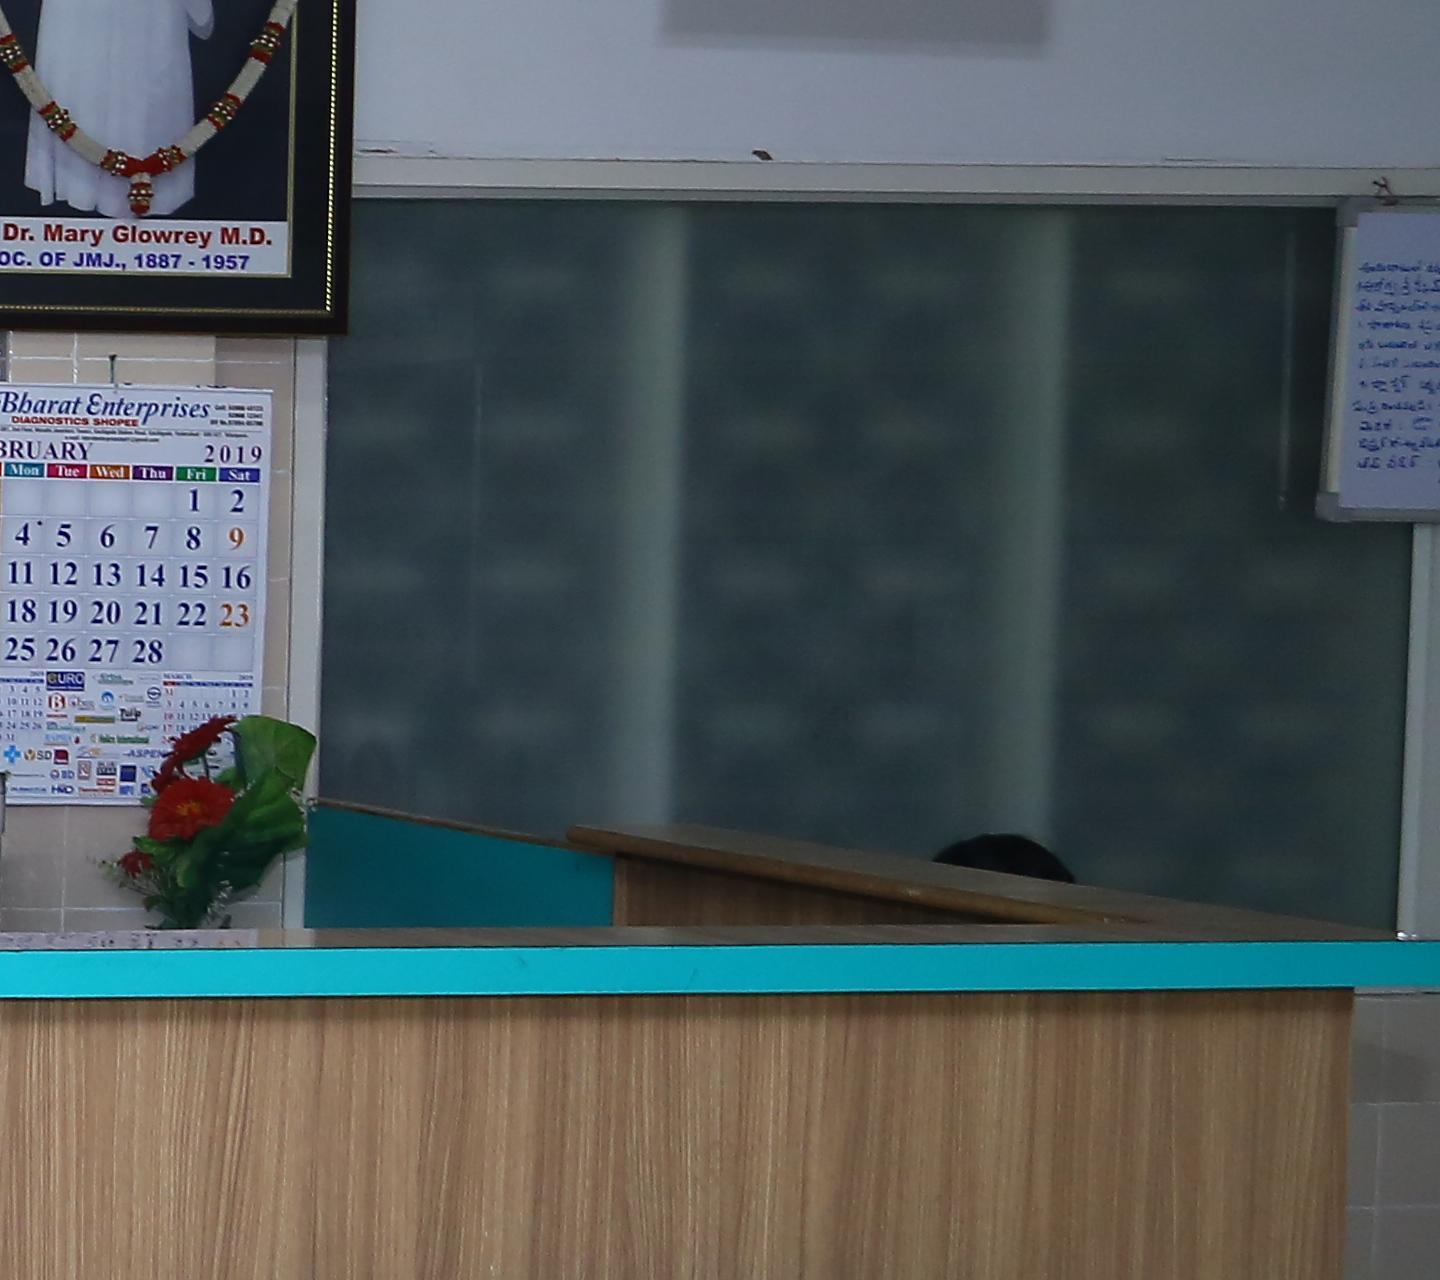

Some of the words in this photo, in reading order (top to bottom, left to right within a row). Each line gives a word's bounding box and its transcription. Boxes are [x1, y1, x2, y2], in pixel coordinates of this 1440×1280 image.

[2, 222, 35, 242] Dr.
[43, 223, 104, 248] Mary
[112, 225, 212, 248] Glowrey
[220, 227, 272, 245] M.D.
[39, 252, 66, 267] OF
[73, 253, 126, 270] JMJ.,
[134, 253, 182, 269] 1887
[202, 255, 250, 270] 1957
[86, 393, 211, 425] Enterprises
[12, 416, 89, 425] DIAGNOSTICS
[93, 415, 138, 427] SHOPEE
[204, 445, 262, 462] 2019
[11, 464, 39, 475] Mon
[58, 465, 79, 476] Tue
[96, 466, 124, 477] Wed
[142, 465, 168, 478] Thu
[187, 469, 206, 480] Fri
[227, 467, 252, 480] Sat
